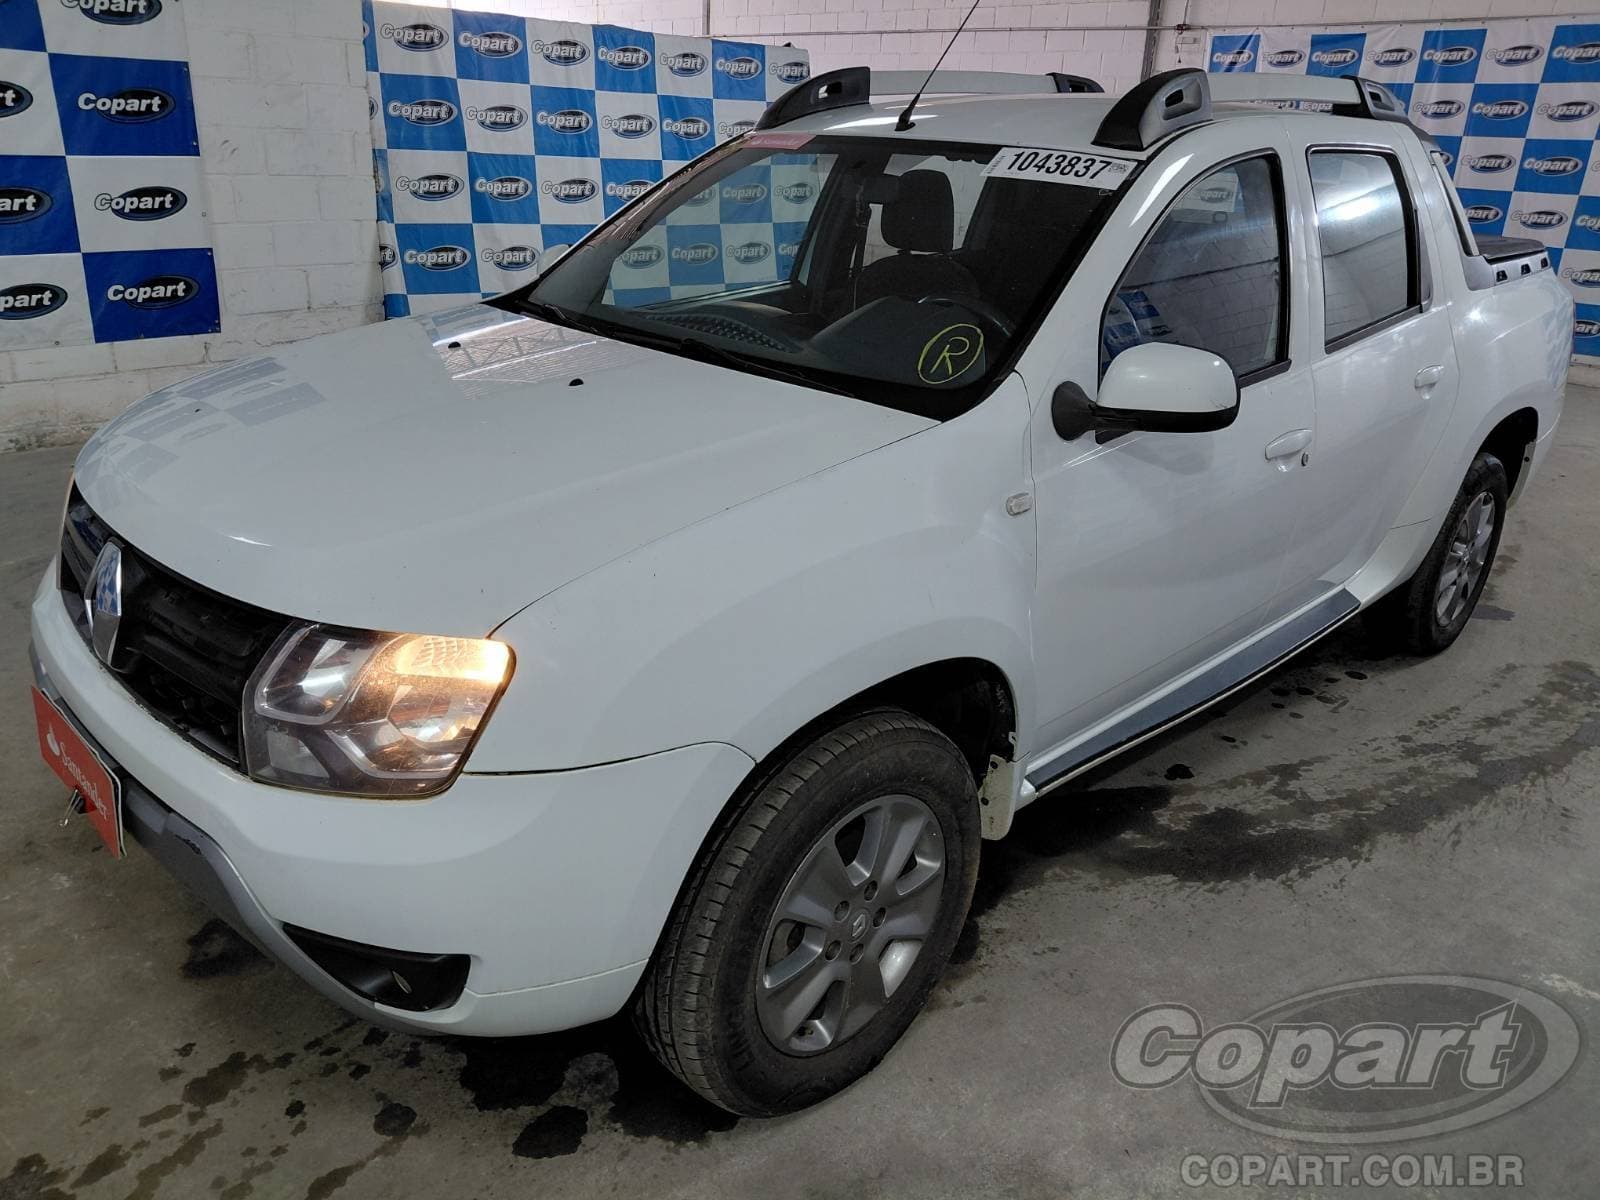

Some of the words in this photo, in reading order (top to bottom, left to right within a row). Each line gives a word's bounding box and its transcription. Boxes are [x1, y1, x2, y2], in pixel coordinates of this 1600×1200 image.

[381, 23, 441, 43] Copart
[458, 32, 515, 51] Copart
[531, 40, 582, 59] Copart
[598, 47, 645, 64] Copart
[1213, 51, 1249, 65] Copart
[1311, 50, 1354, 66] Copart
[1367, 50, 1411, 66] Copart
[1422, 50, 1470, 65] Copart
[1485, 48, 1535, 64] Copart
[1552, 45, 1600, 62] Copar
[660, 53, 703, 69] Copart
[715, 58, 756, 74] Copart
[1262, 51, 1301, 66] Copart
[769, 63, 809, 78] Copart
[78, 92, 161, 114] Copart
[388, 101, 450, 120] Copart
[1304, 101, 1333, 113] Copa
[1413, 103, 1457, 118] Copart
[1472, 102, 1521, 119] Copart
[1537, 103, 1590, 120] Copart
[465, 106, 521, 124] Copart
[537, 111, 588, 129] Copart
[601, 115, 650, 132] Copart
[662, 119, 704, 136] Copart
[1007, 151, 1113, 180] 1043837
[1461, 155, 1511, 172] Copart
[1523, 157, 1575, 174] Copart
[396, 175, 456, 195] Copart
[475, 177, 526, 194] Copart
[541, 179, 592, 197] Copart
[606, 183, 650, 197] Copar
[722, 186, 762, 201] Copart
[775, 184, 811, 200] Copart
[94, 192, 173, 213] Copart
[1511, 210, 1563, 227] Copart
[404, 247, 463, 265] Copart
[481, 248, 533, 264] Copart
[672, 246, 714, 261] Copart
[726, 243, 766, 259] Copart
[1561, 267, 1600, 284] Copa
[107, 281, 187, 302] Copart
[929, 336, 970, 377] R
